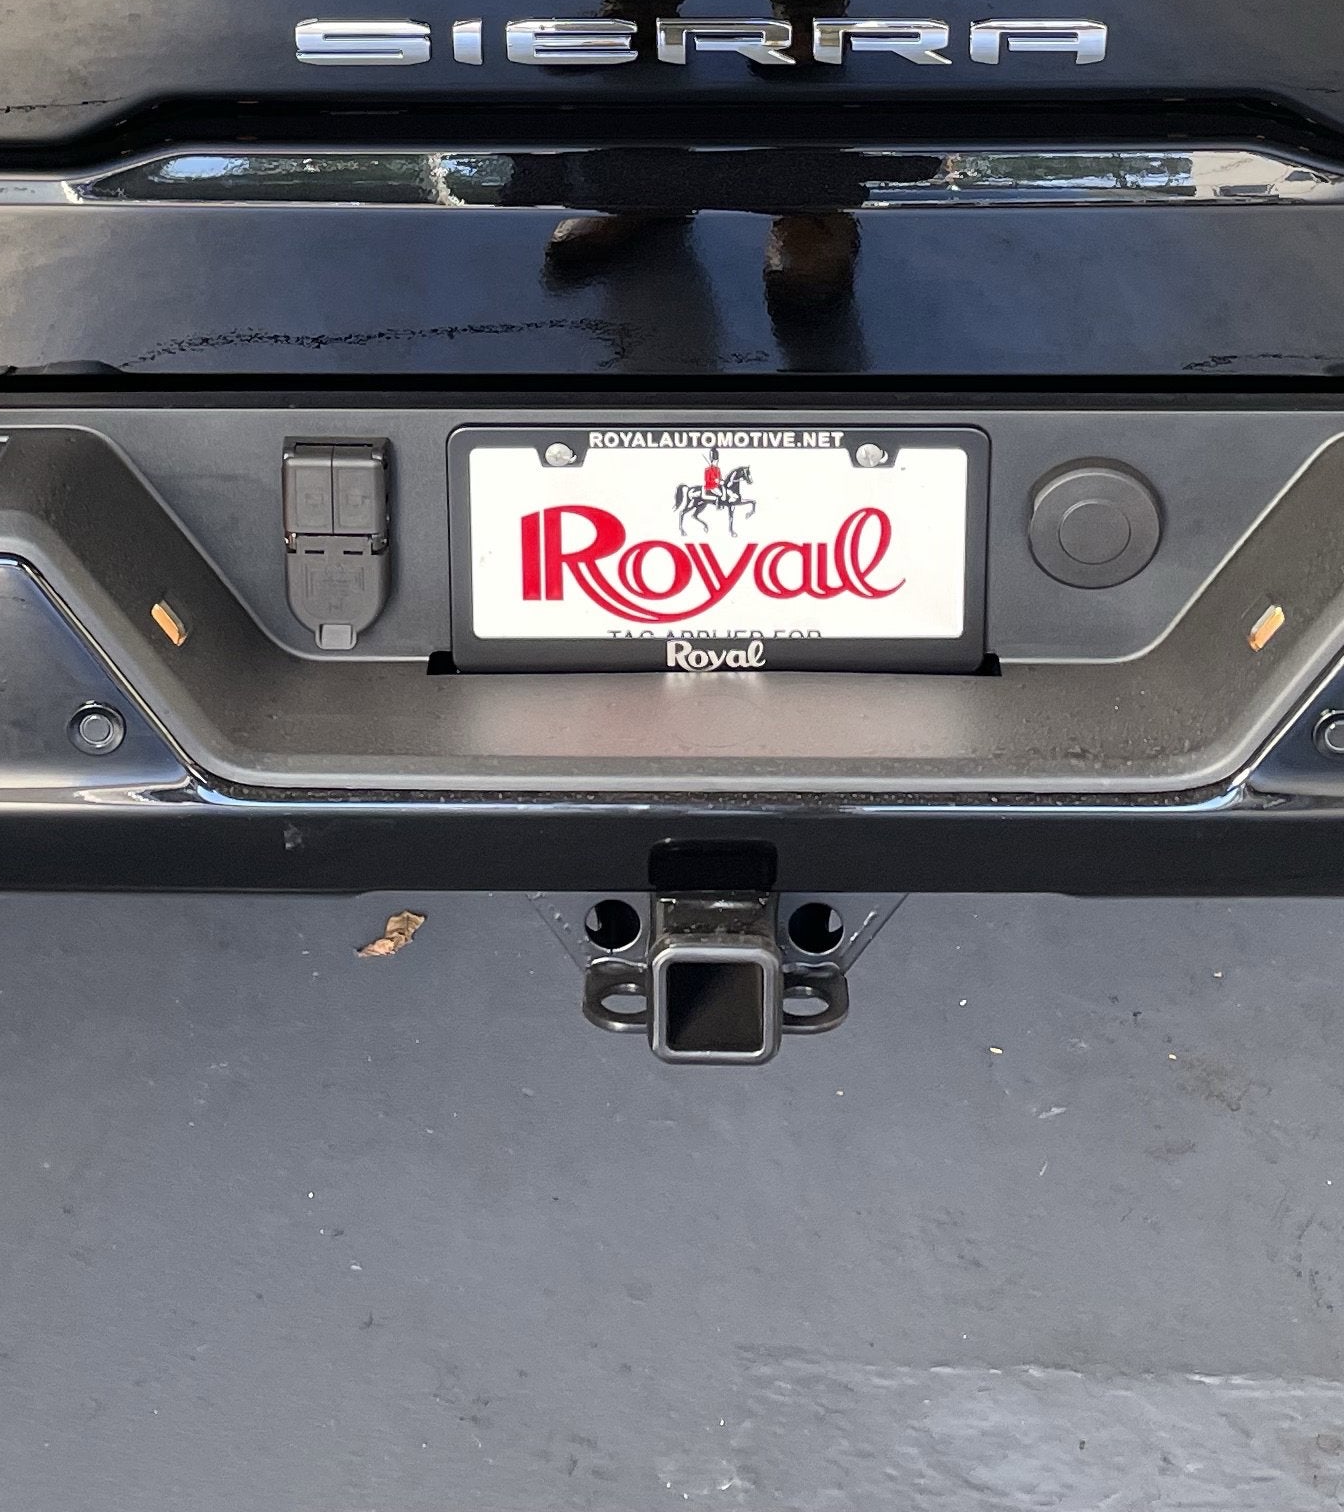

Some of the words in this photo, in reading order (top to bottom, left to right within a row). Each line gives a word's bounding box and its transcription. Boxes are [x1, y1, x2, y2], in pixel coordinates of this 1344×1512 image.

[295, 17, 1109, 65] SIERRA
[588, 430, 845, 448] ROYALAUTOMOTIVE.NET
[520, 504, 907, 624] Royal
[666, 639, 767, 672] Royal
